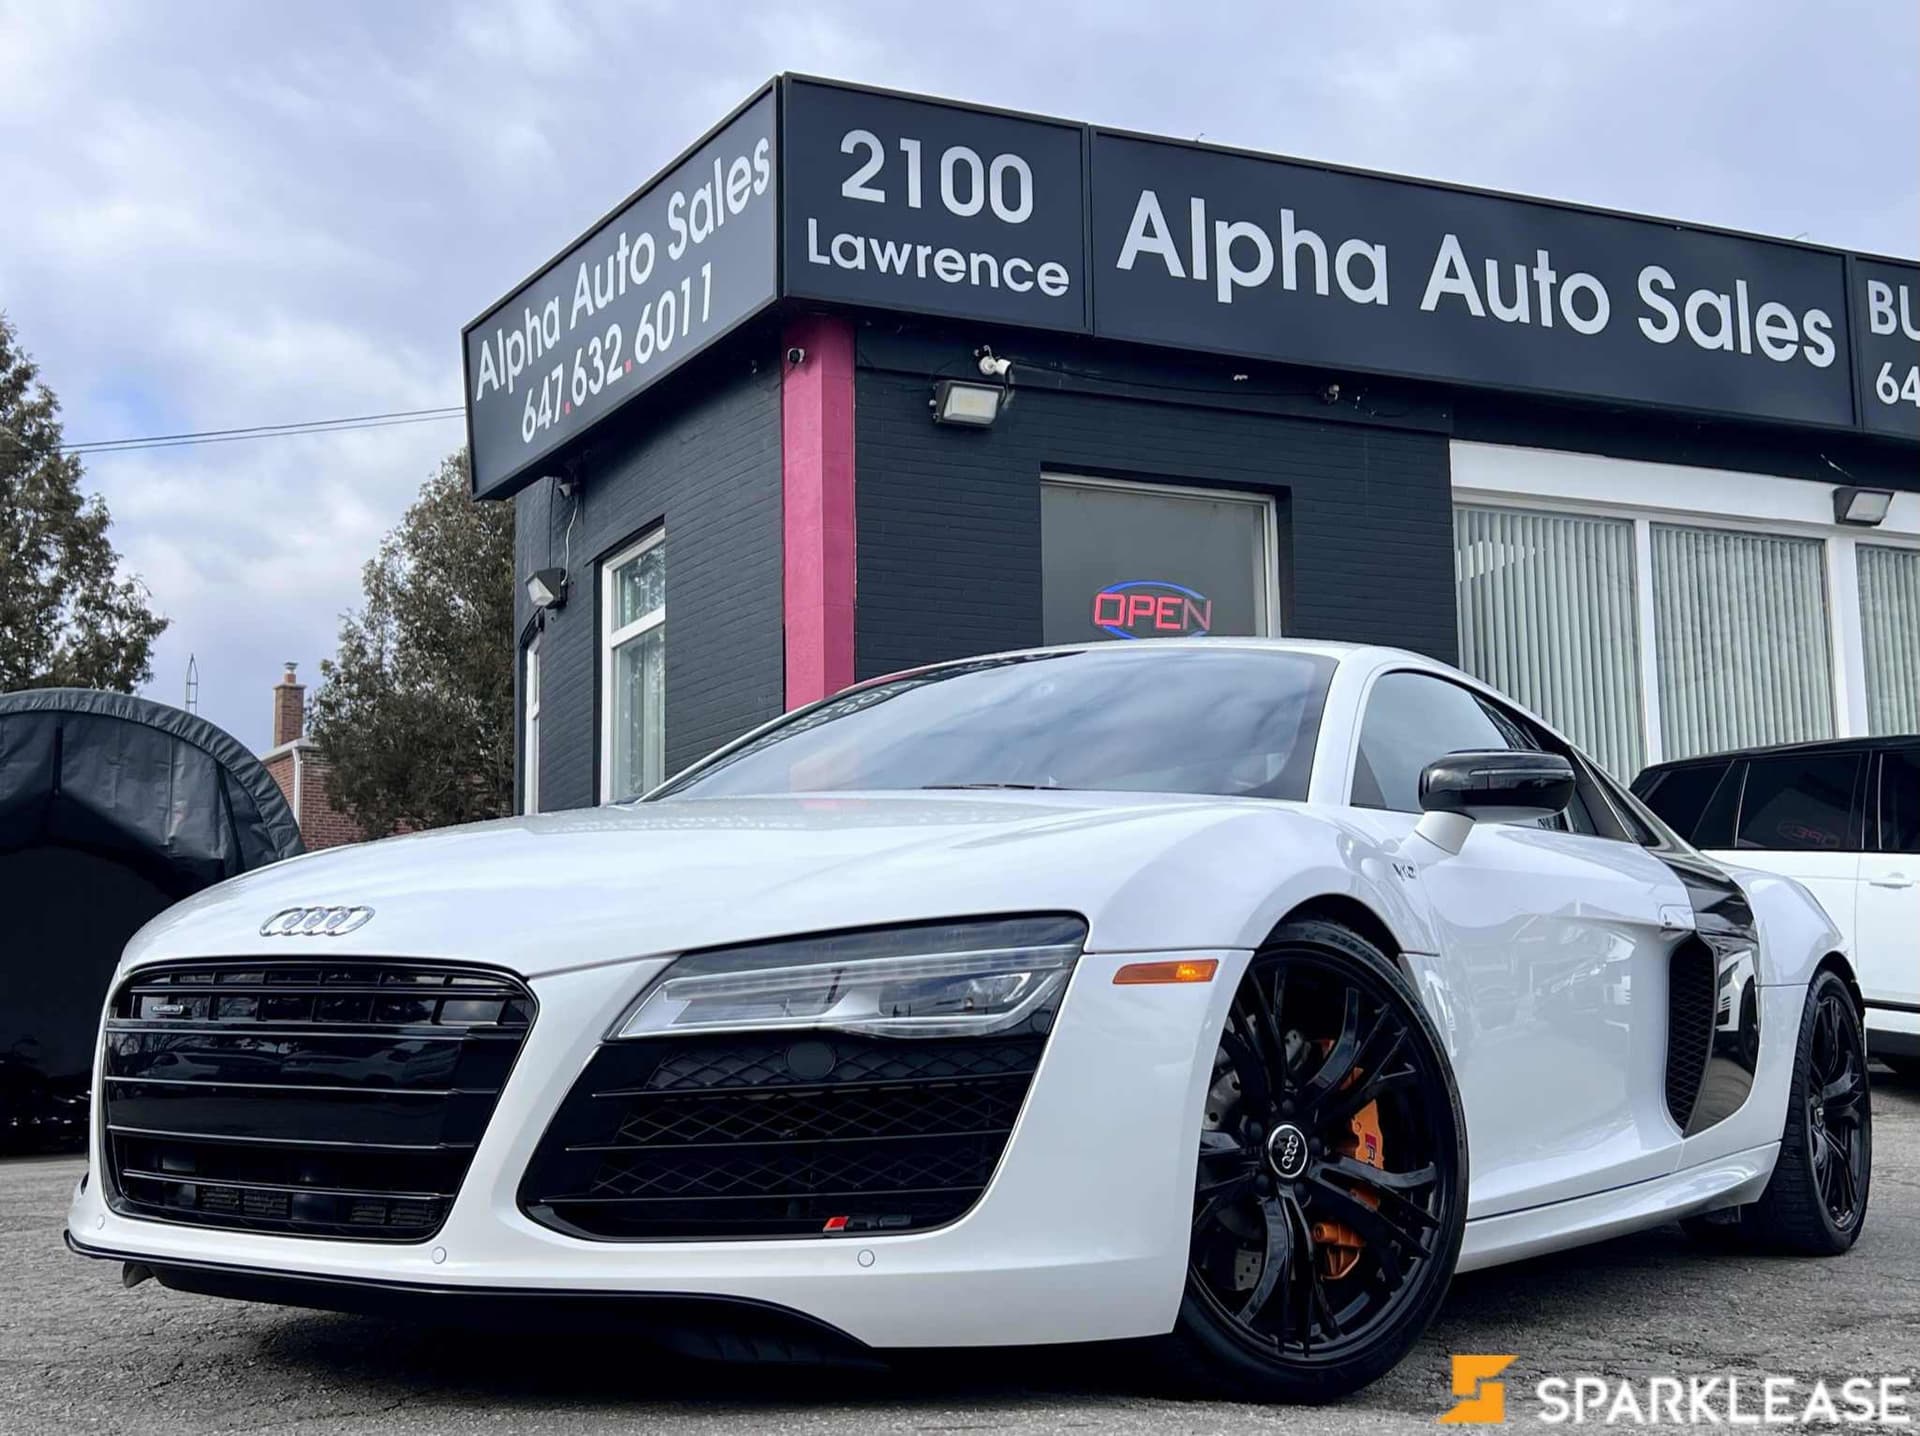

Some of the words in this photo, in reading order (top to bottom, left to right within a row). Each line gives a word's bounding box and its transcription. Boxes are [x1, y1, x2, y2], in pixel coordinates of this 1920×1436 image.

[840, 129, 1034, 224] 2100
[475, 295, 562, 402] Alpha
[568, 231, 656, 331] Auto
[667, 136, 771, 262] Sales
[808, 217, 1070, 297] Lawrence
[1116, 190, 1389, 306] Alpha
[1420, 233, 1610, 335] Auto
[1637, 265, 1836, 368] Sales
[521, 261, 712, 444] 647.632.6011
[1094, 592, 1212, 632] OPEN
